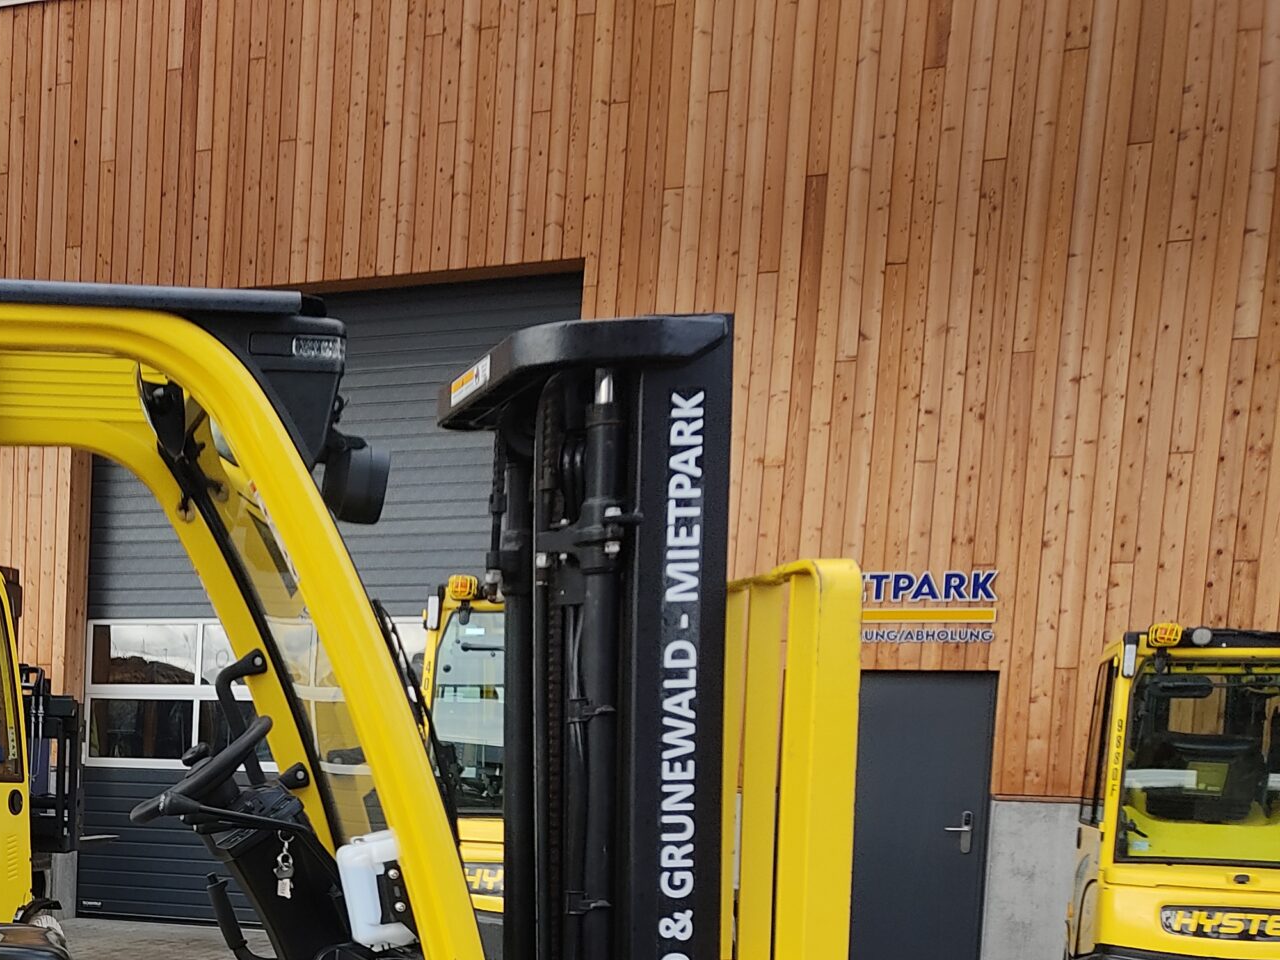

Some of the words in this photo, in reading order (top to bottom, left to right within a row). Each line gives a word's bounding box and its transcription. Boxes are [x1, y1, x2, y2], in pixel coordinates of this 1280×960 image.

[665, 390, 706, 602] MIETPARK
[862, 571, 998, 602] TPARK
[680, 612, 689, 629] -
[863, 628, 994, 642] UNG/ABHOLUNG
[659, 639, 698, 899] GRUNEWALD
[658, 909, 694, 942] &
